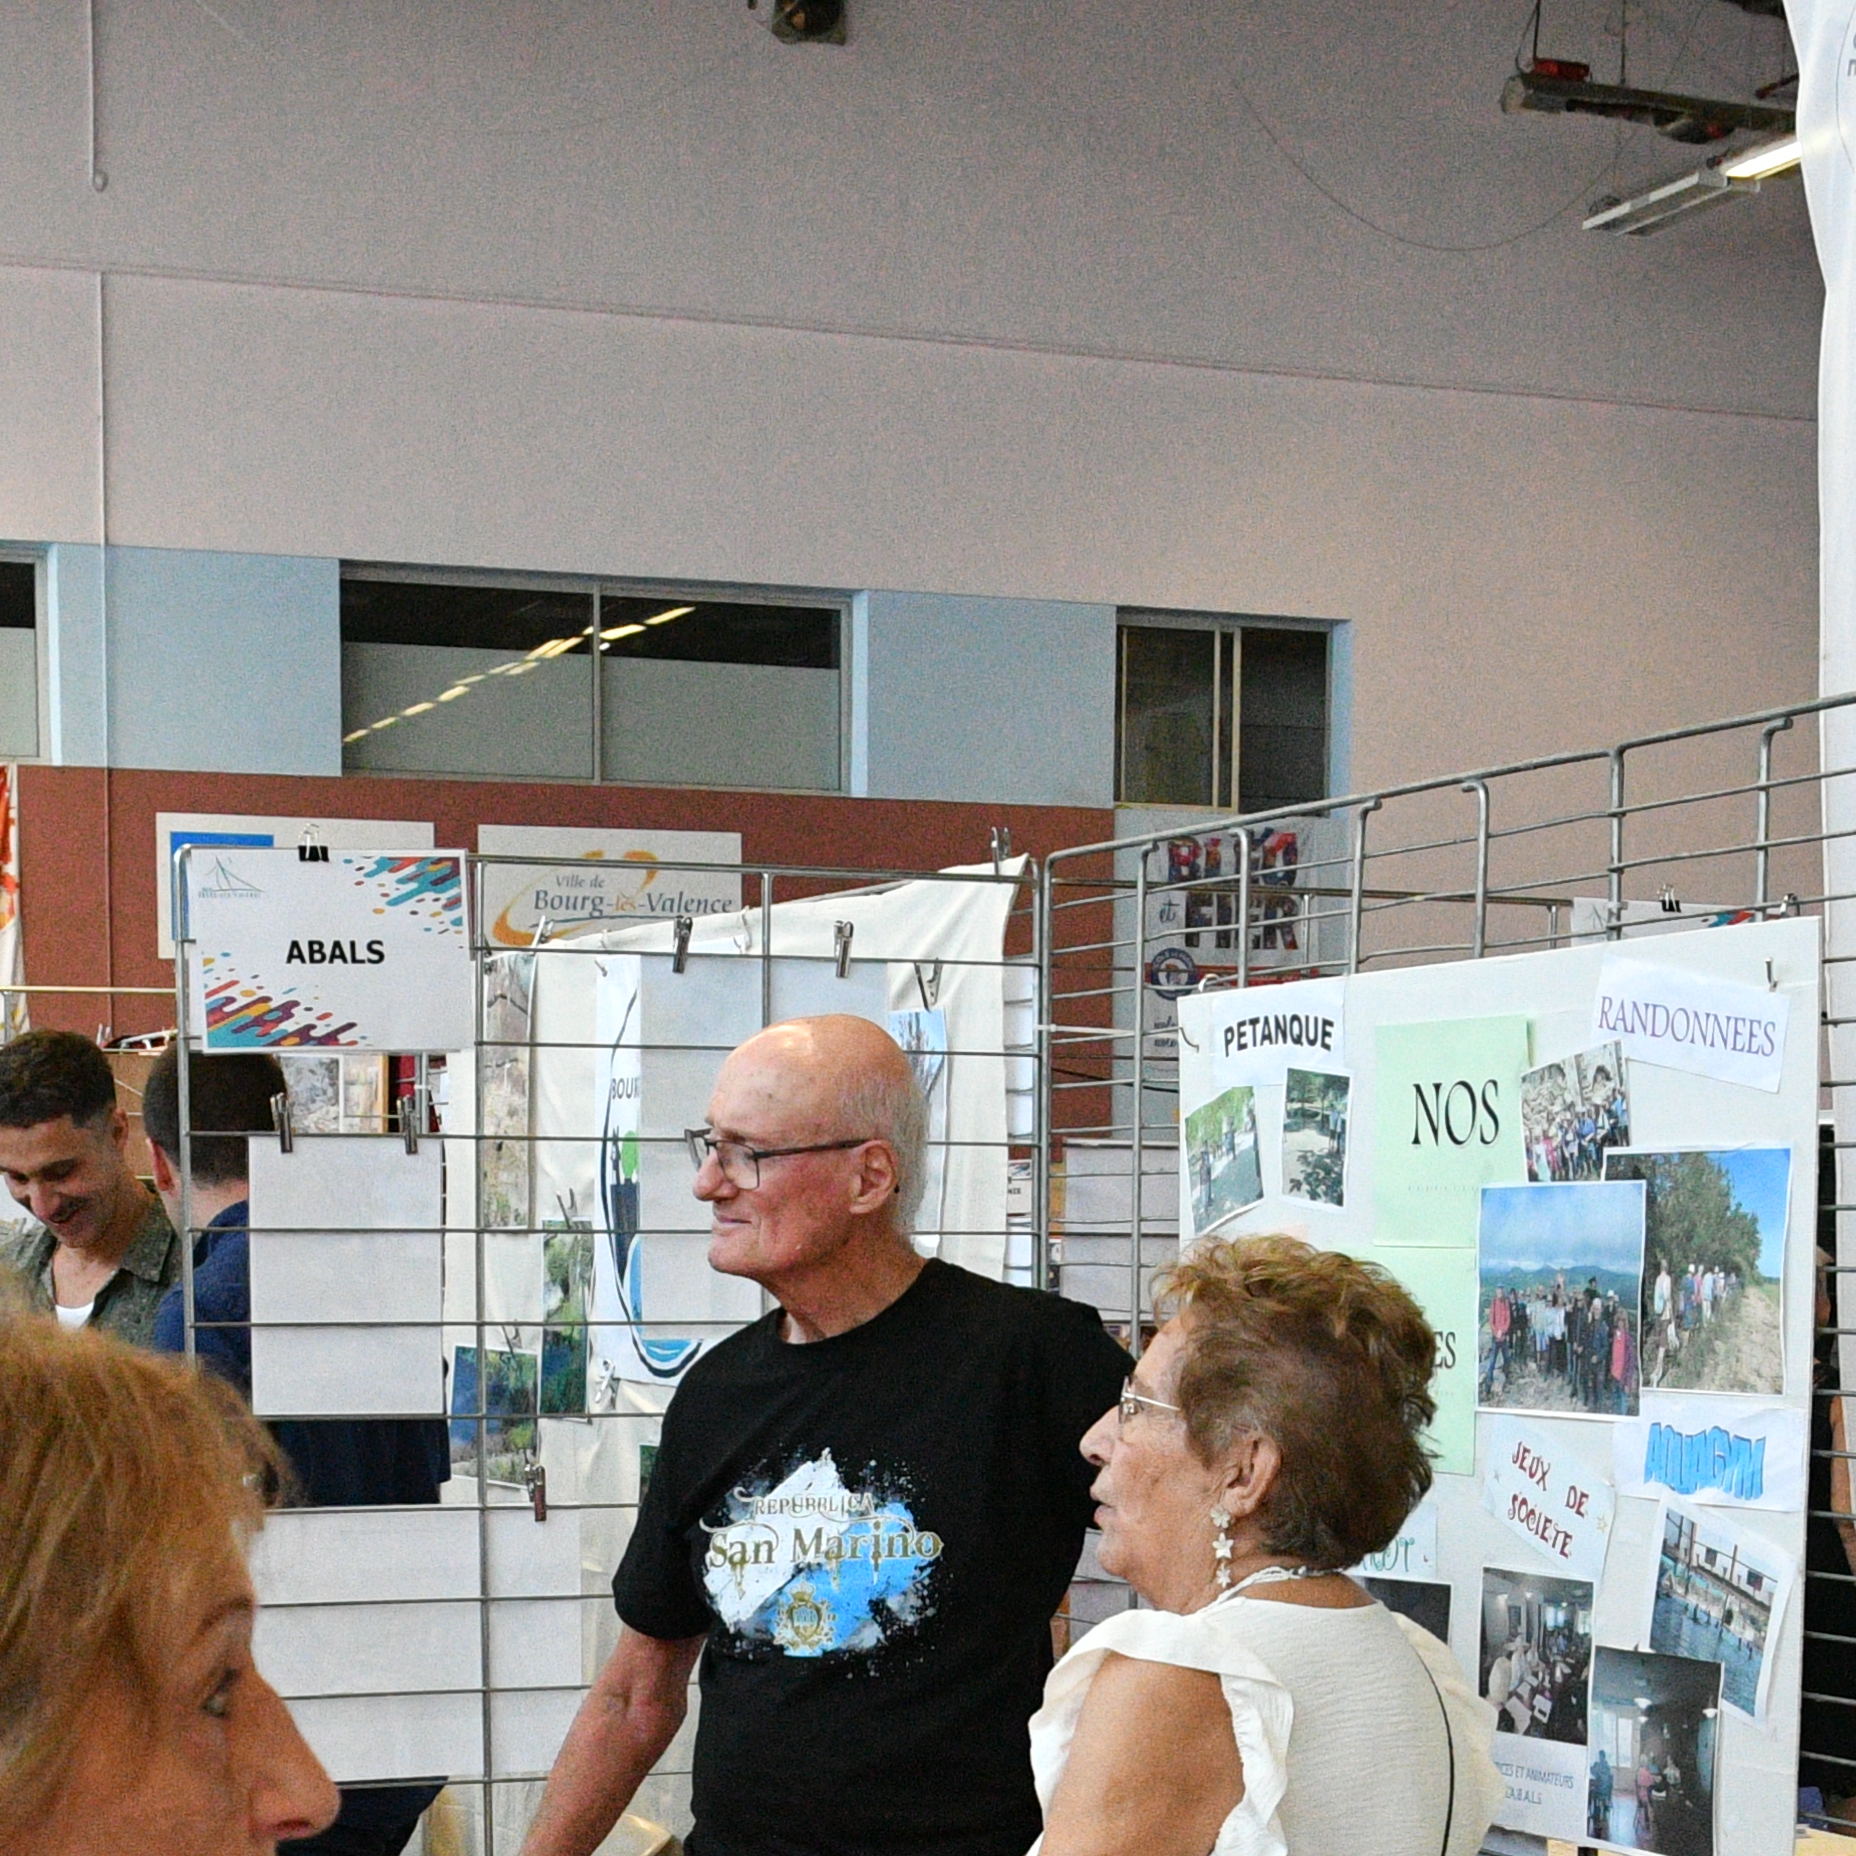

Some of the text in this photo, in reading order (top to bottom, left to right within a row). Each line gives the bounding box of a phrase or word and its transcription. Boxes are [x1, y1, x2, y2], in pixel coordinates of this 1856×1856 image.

[556, 875, 605, 889] Ville de
[286, 940, 385, 964] ABALS
[1223, 1013, 1335, 1058] PETANQUE
[1597, 995, 1778, 1058] RANDONNEES
[1411, 1079, 1500, 1147] NOS
[1511, 1440, 1589, 1518] JEUX DE
[1644, 1421, 1768, 1500] AQUAGYM
[708, 1520, 945, 1569] San Marino
